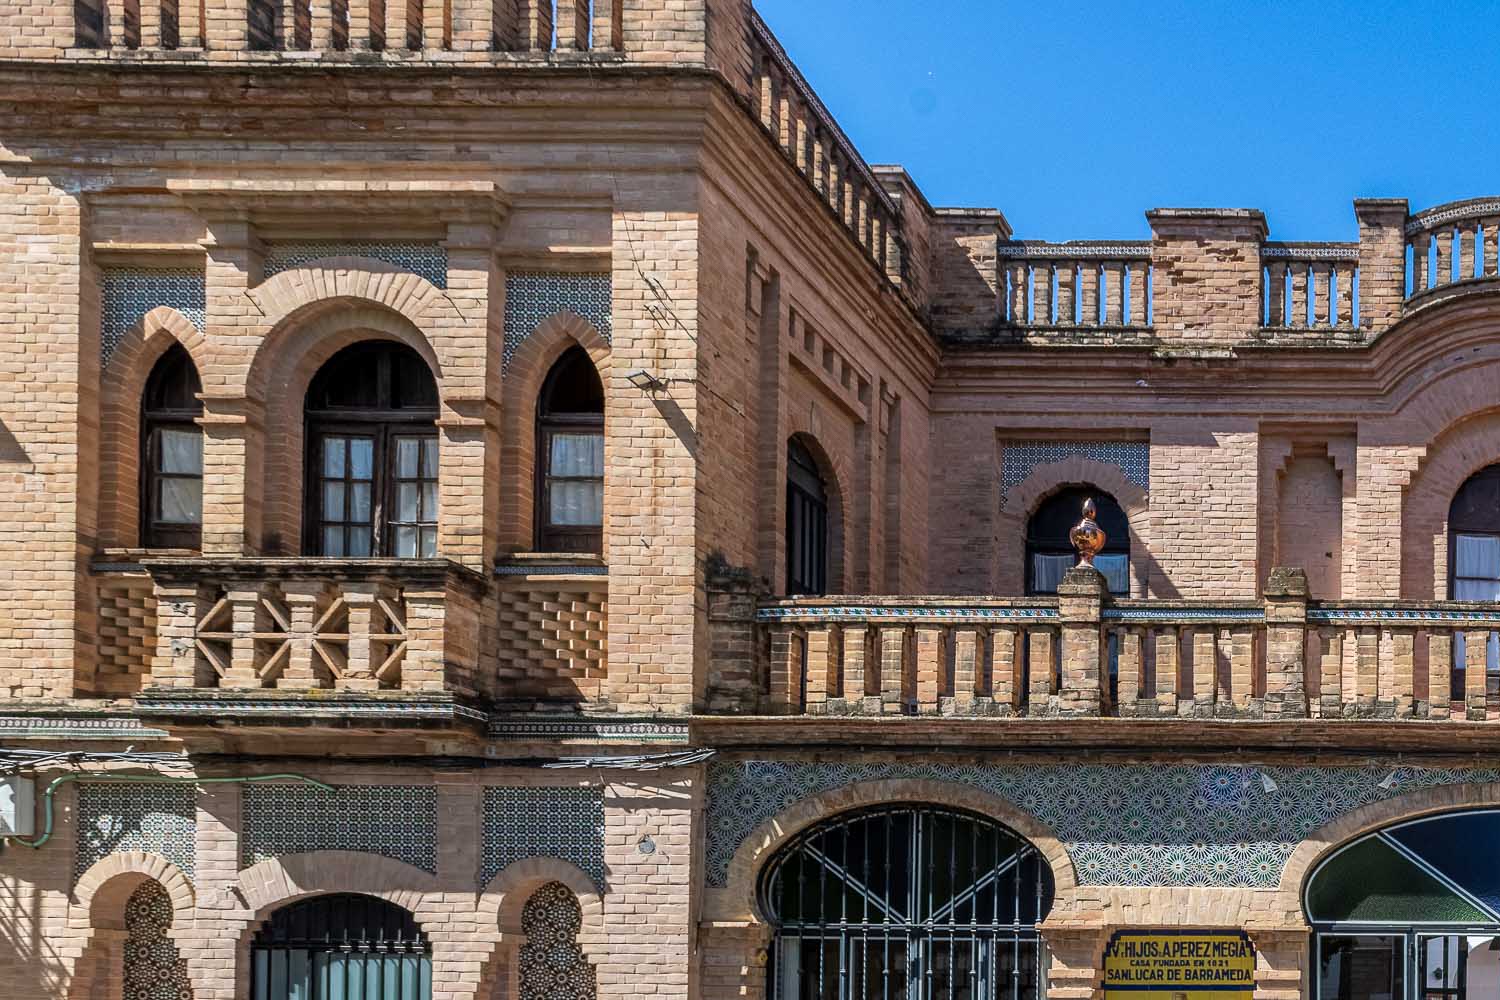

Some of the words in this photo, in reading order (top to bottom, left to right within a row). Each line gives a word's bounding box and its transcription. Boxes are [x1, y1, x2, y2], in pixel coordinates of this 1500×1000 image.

[1124, 941, 1159, 958] HIJOS
[1172, 941, 1210, 958] PEREZ
[1130, 959, 1151, 967] CASA
[1153, 959, 1190, 967] FUNDADA
[1193, 959, 1205, 967] EN
[1107, 968, 1164, 981] SANLUCAR
[1167, 968, 1182, 981] DE
[1184, 968, 1252, 981] BARRAMEDA
